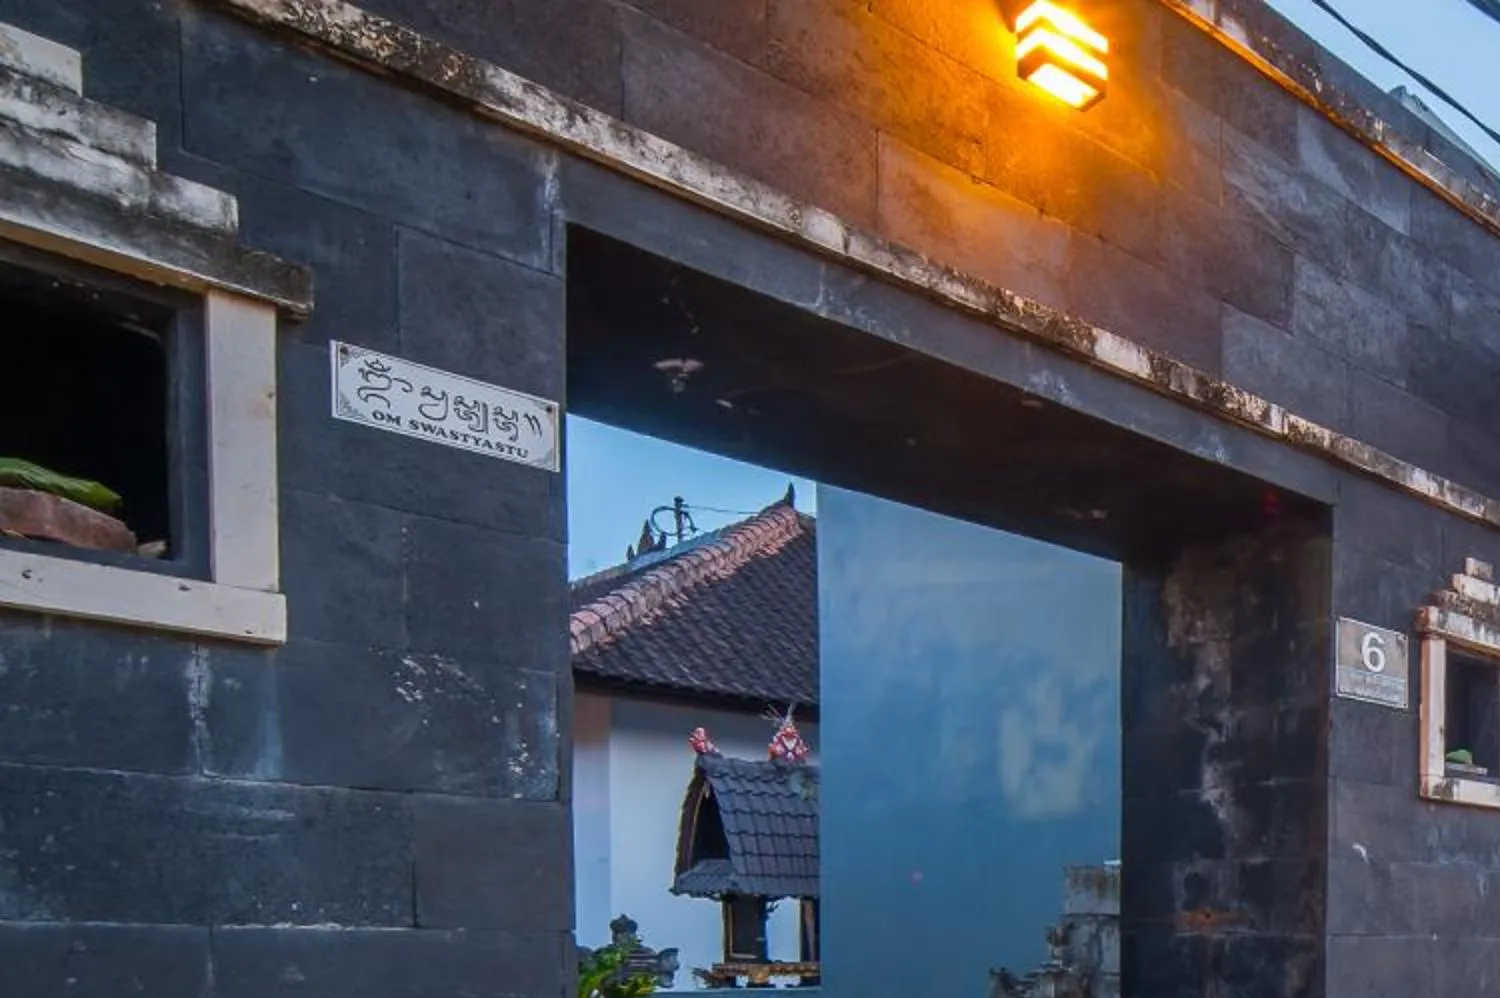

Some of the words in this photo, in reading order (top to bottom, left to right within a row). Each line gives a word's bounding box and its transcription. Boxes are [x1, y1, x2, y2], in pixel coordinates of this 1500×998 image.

[372, 410, 401, 426] OM
[409, 419, 529, 459] SWASTYASTU
[1361, 631, 1385, 673] 6
